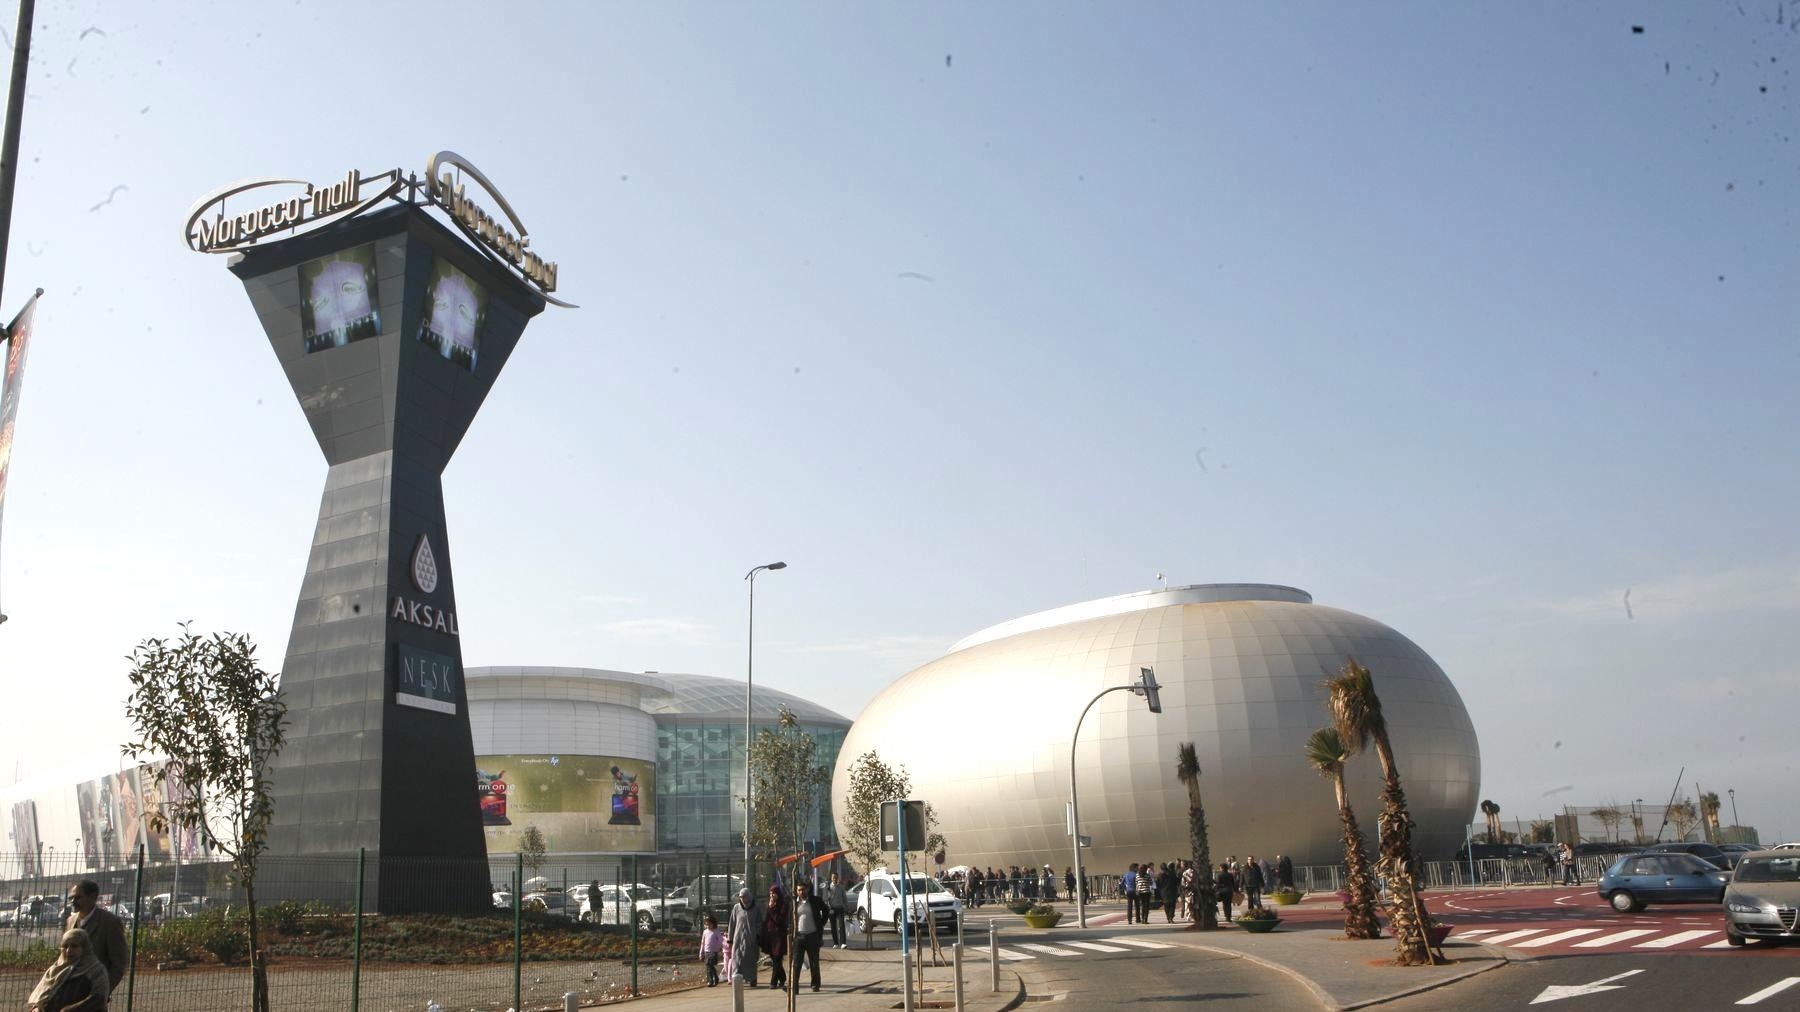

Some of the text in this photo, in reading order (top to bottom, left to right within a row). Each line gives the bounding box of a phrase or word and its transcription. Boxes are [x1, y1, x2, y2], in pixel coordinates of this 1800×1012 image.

[197, 197, 302, 249] Morocco
[392, 596, 459, 636] AKSAL
[404, 657, 451, 693] NESK
